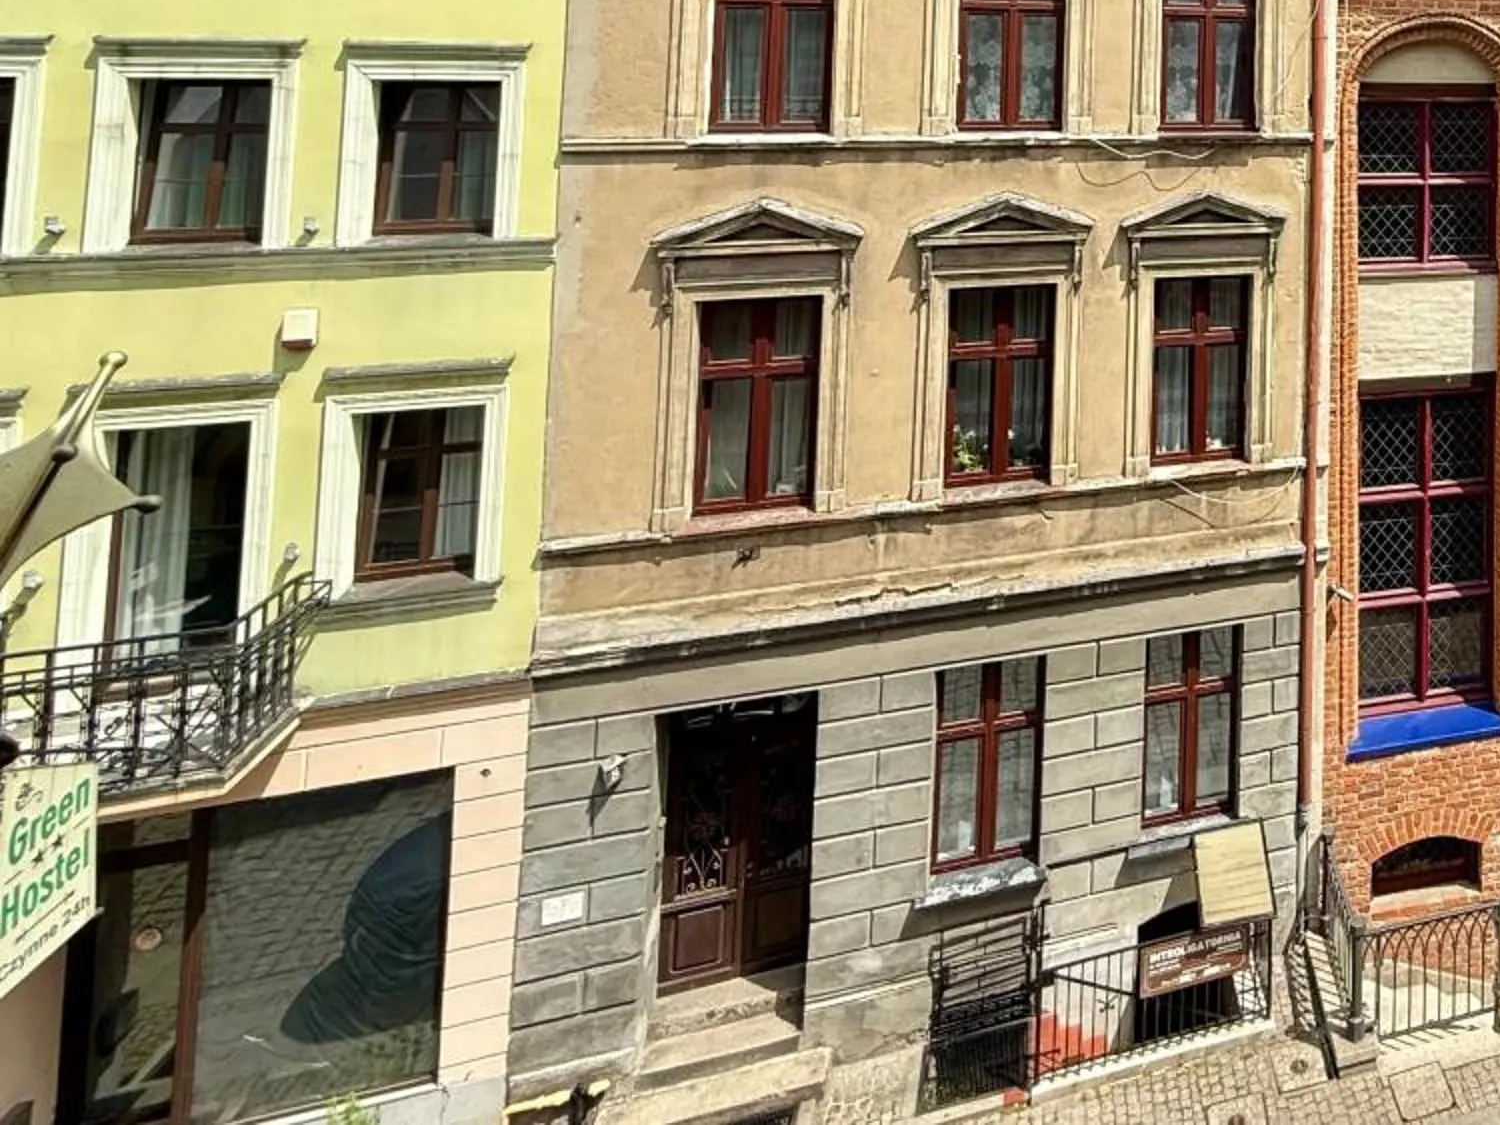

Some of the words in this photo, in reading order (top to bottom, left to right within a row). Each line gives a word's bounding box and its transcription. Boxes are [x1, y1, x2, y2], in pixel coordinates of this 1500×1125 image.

[9, 778, 90, 866] Green
[0, 827, 90, 939] Hostel
[62, 895, 91, 927] 24h
